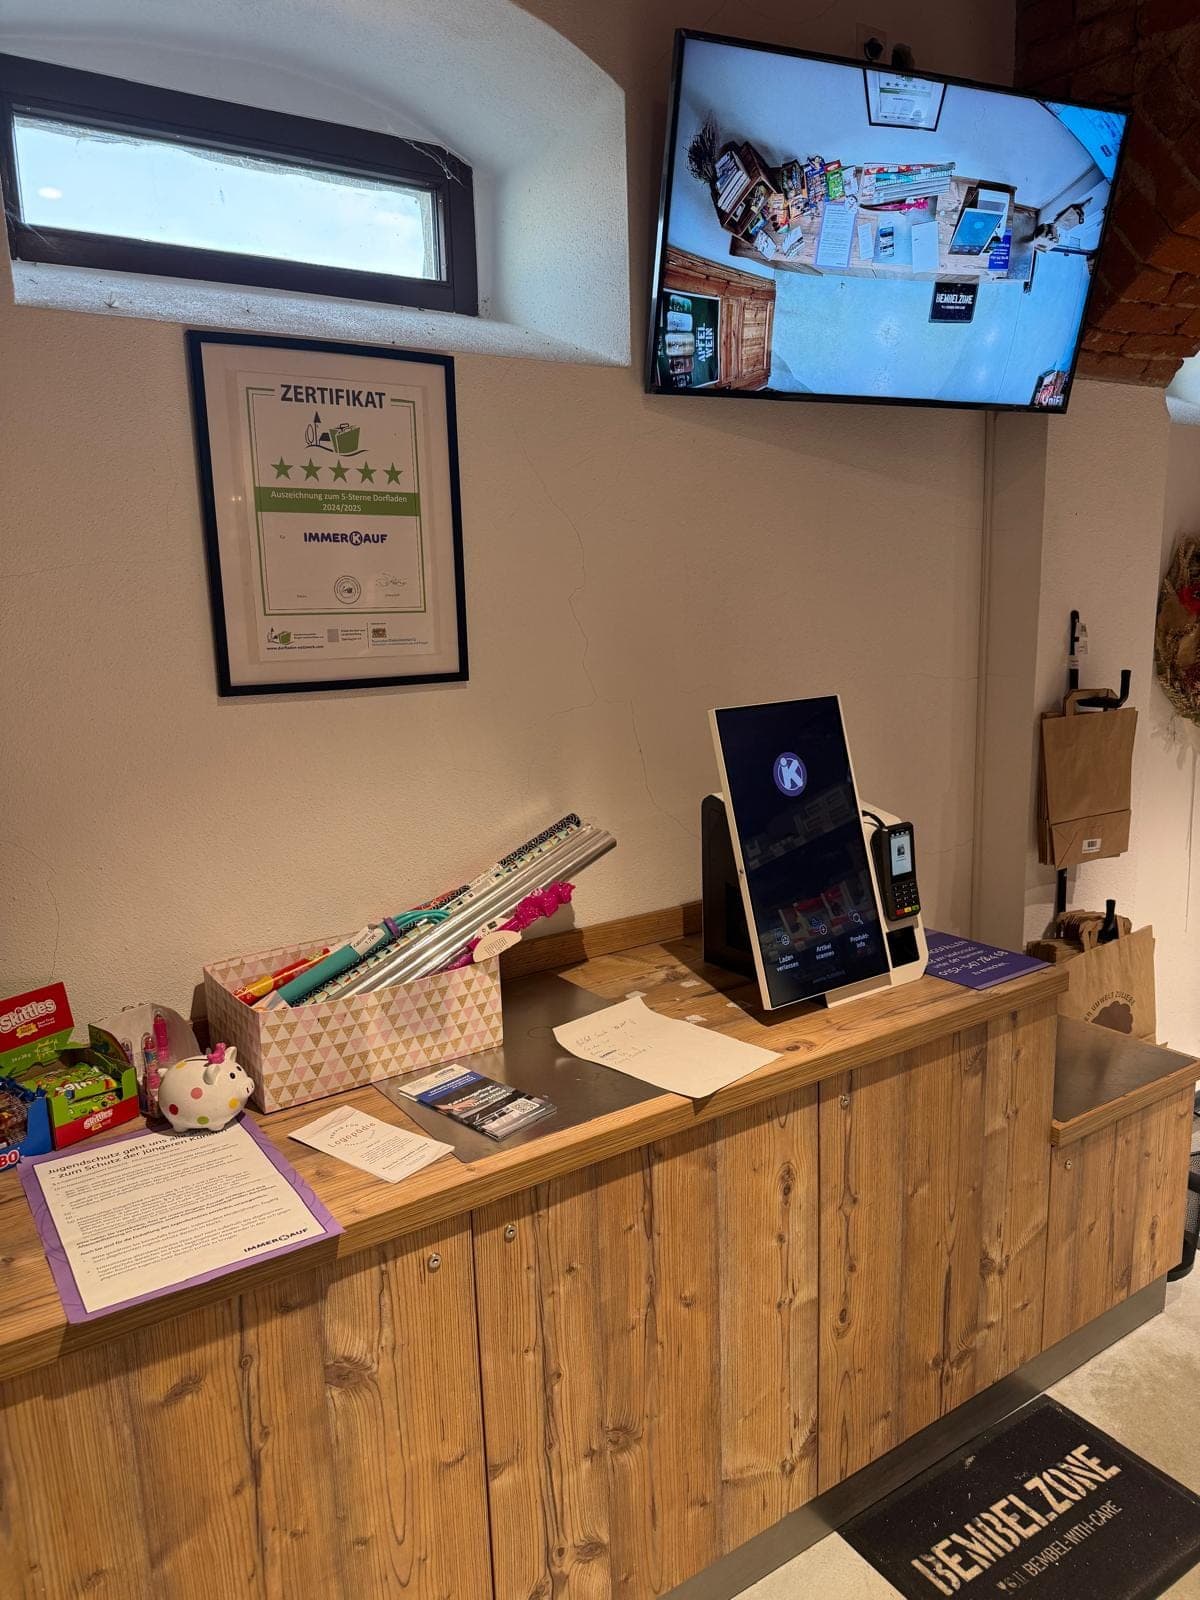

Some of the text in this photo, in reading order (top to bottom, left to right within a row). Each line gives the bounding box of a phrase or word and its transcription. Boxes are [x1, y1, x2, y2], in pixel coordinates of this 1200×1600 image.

[280, 384, 386, 409] ZERTIFIKAT
[270, 490, 408, 503] Auszeichnung zum 5-Sterne Dorfladen
[322, 503, 362, 513] 2024/2025
[778, 954, 794, 964] Laden
[0, 999, 56, 1034] Skittles
[48, 1152, 120, 1175] Jugendschutz
[122, 1144, 145, 1156] geht
[148, 1138, 168, 1147] uns
[59, 1168, 83, 1178] zum
[84, 1158, 119, 1173] Schutz
[122, 1151, 140, 1161] der
[141, 1139, 188, 1156] jüngeren
